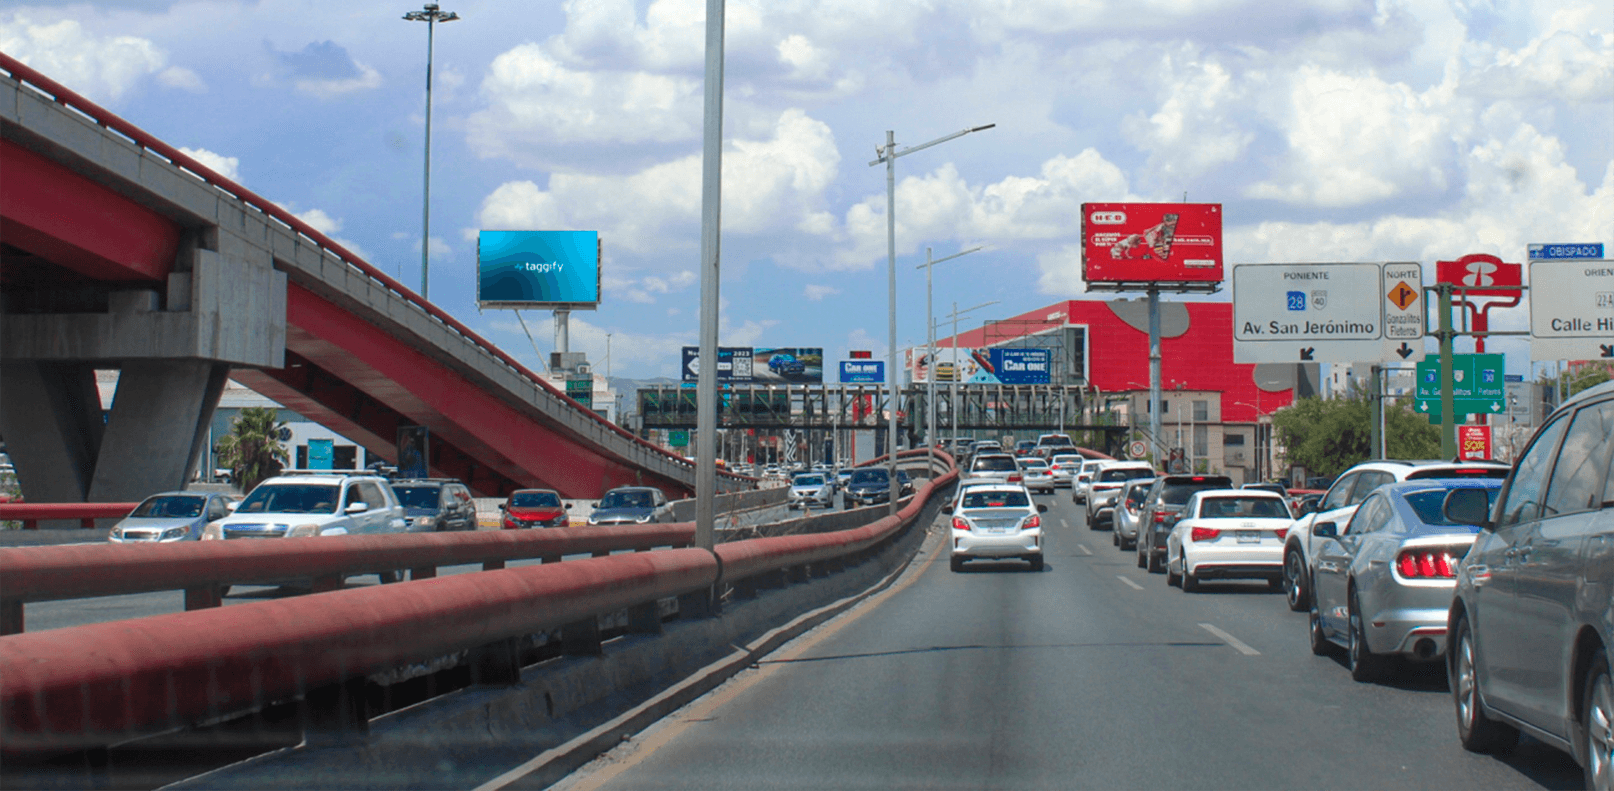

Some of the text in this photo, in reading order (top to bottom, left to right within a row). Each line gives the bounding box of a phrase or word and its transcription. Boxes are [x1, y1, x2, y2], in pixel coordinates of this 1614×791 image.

[1549, 245, 1598, 257] OBISPADO
[525, 261, 564, 273] taggify
[1283, 272, 1330, 280] PONIENTE
[1386, 270, 1418, 279] NORTE
[1584, 269, 1614, 277] ORIEN
[1288, 295, 1325, 310] 28 40
[1386, 313, 1421, 324] Gonzalitos
[1243, 320, 1374, 334] Av. San Jerónimo
[1551, 318, 1592, 331] Calle
[1390, 325, 1417, 336] Fleteros
[845, 362, 861, 373] CAR
[1004, 359, 1045, 371] CAR ONE
